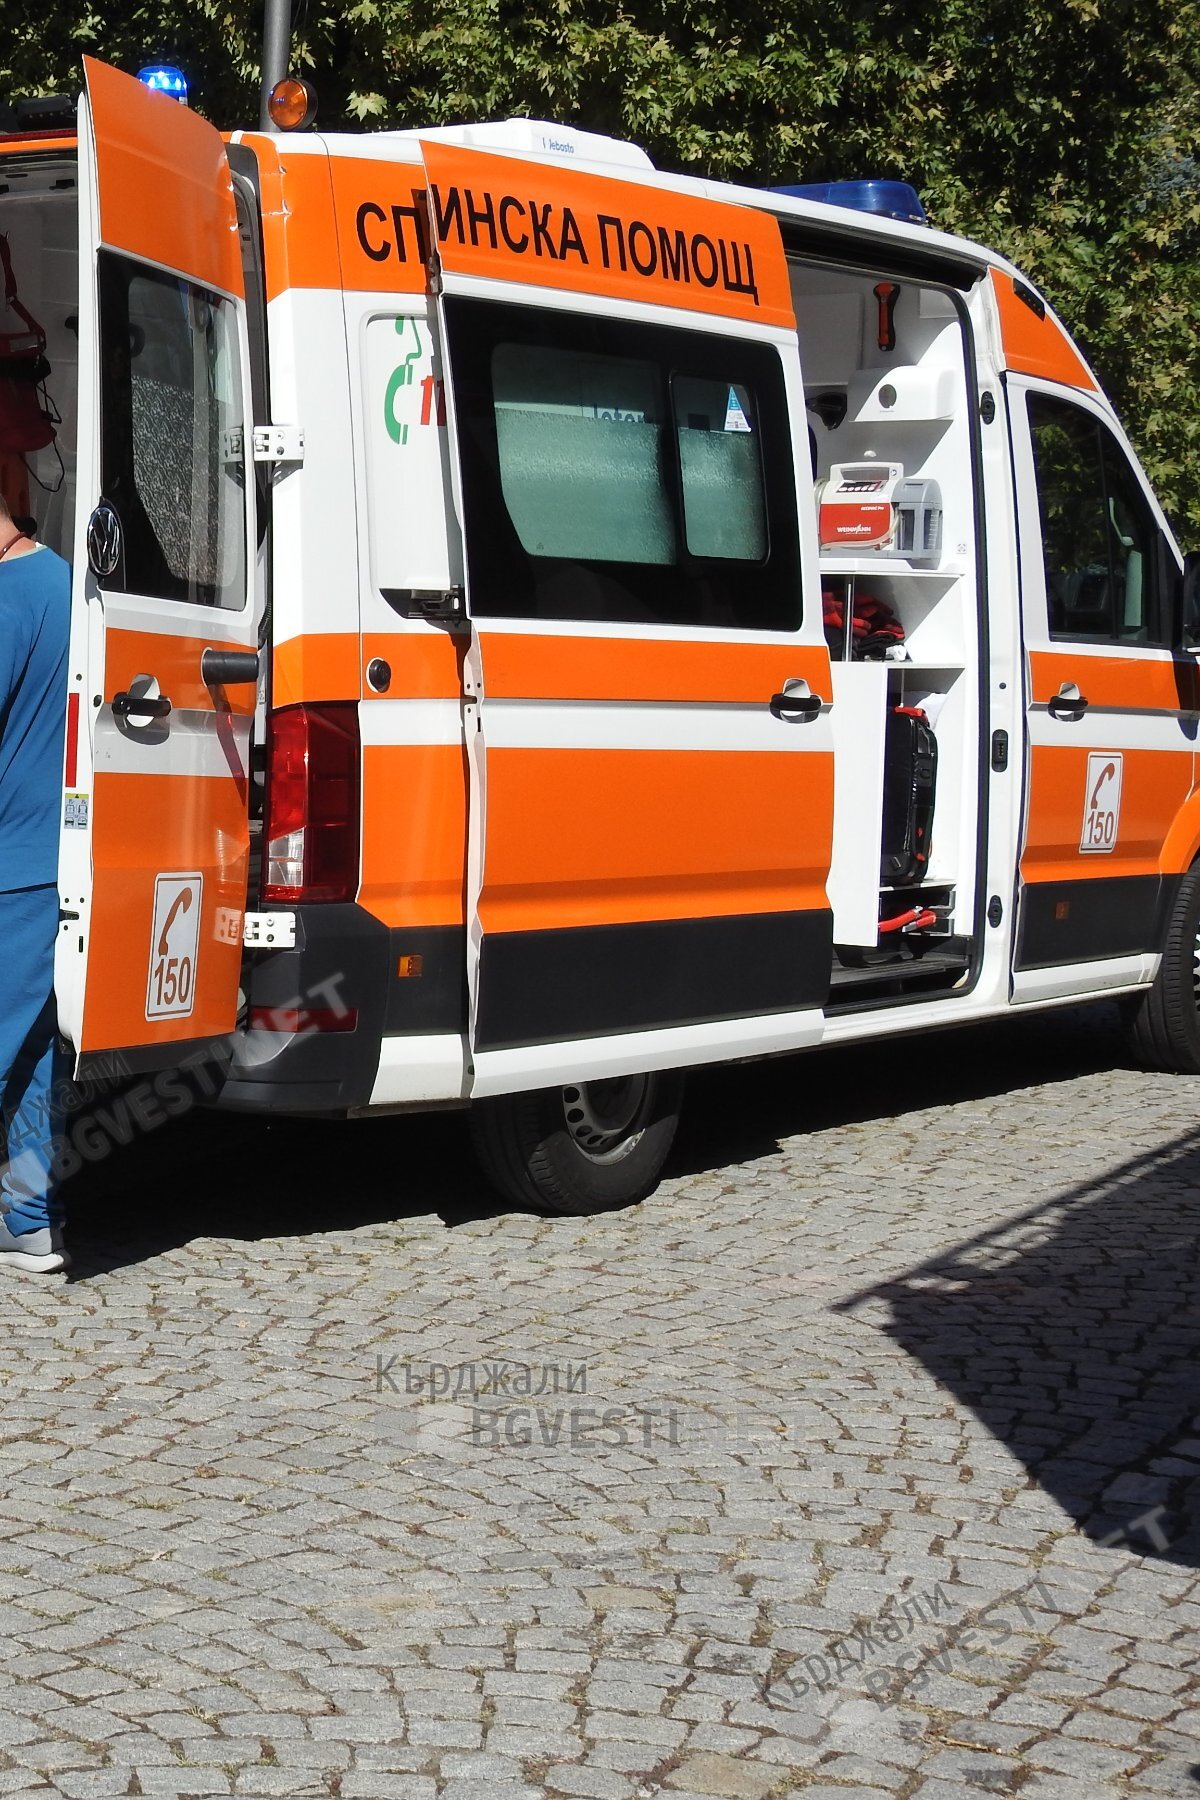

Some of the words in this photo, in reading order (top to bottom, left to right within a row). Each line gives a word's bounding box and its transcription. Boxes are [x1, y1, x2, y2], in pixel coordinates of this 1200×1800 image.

[598, 214, 759, 306] ПОМОЩ
[1087, 811, 1115, 845] 150
[153, 955, 192, 1006] 150
